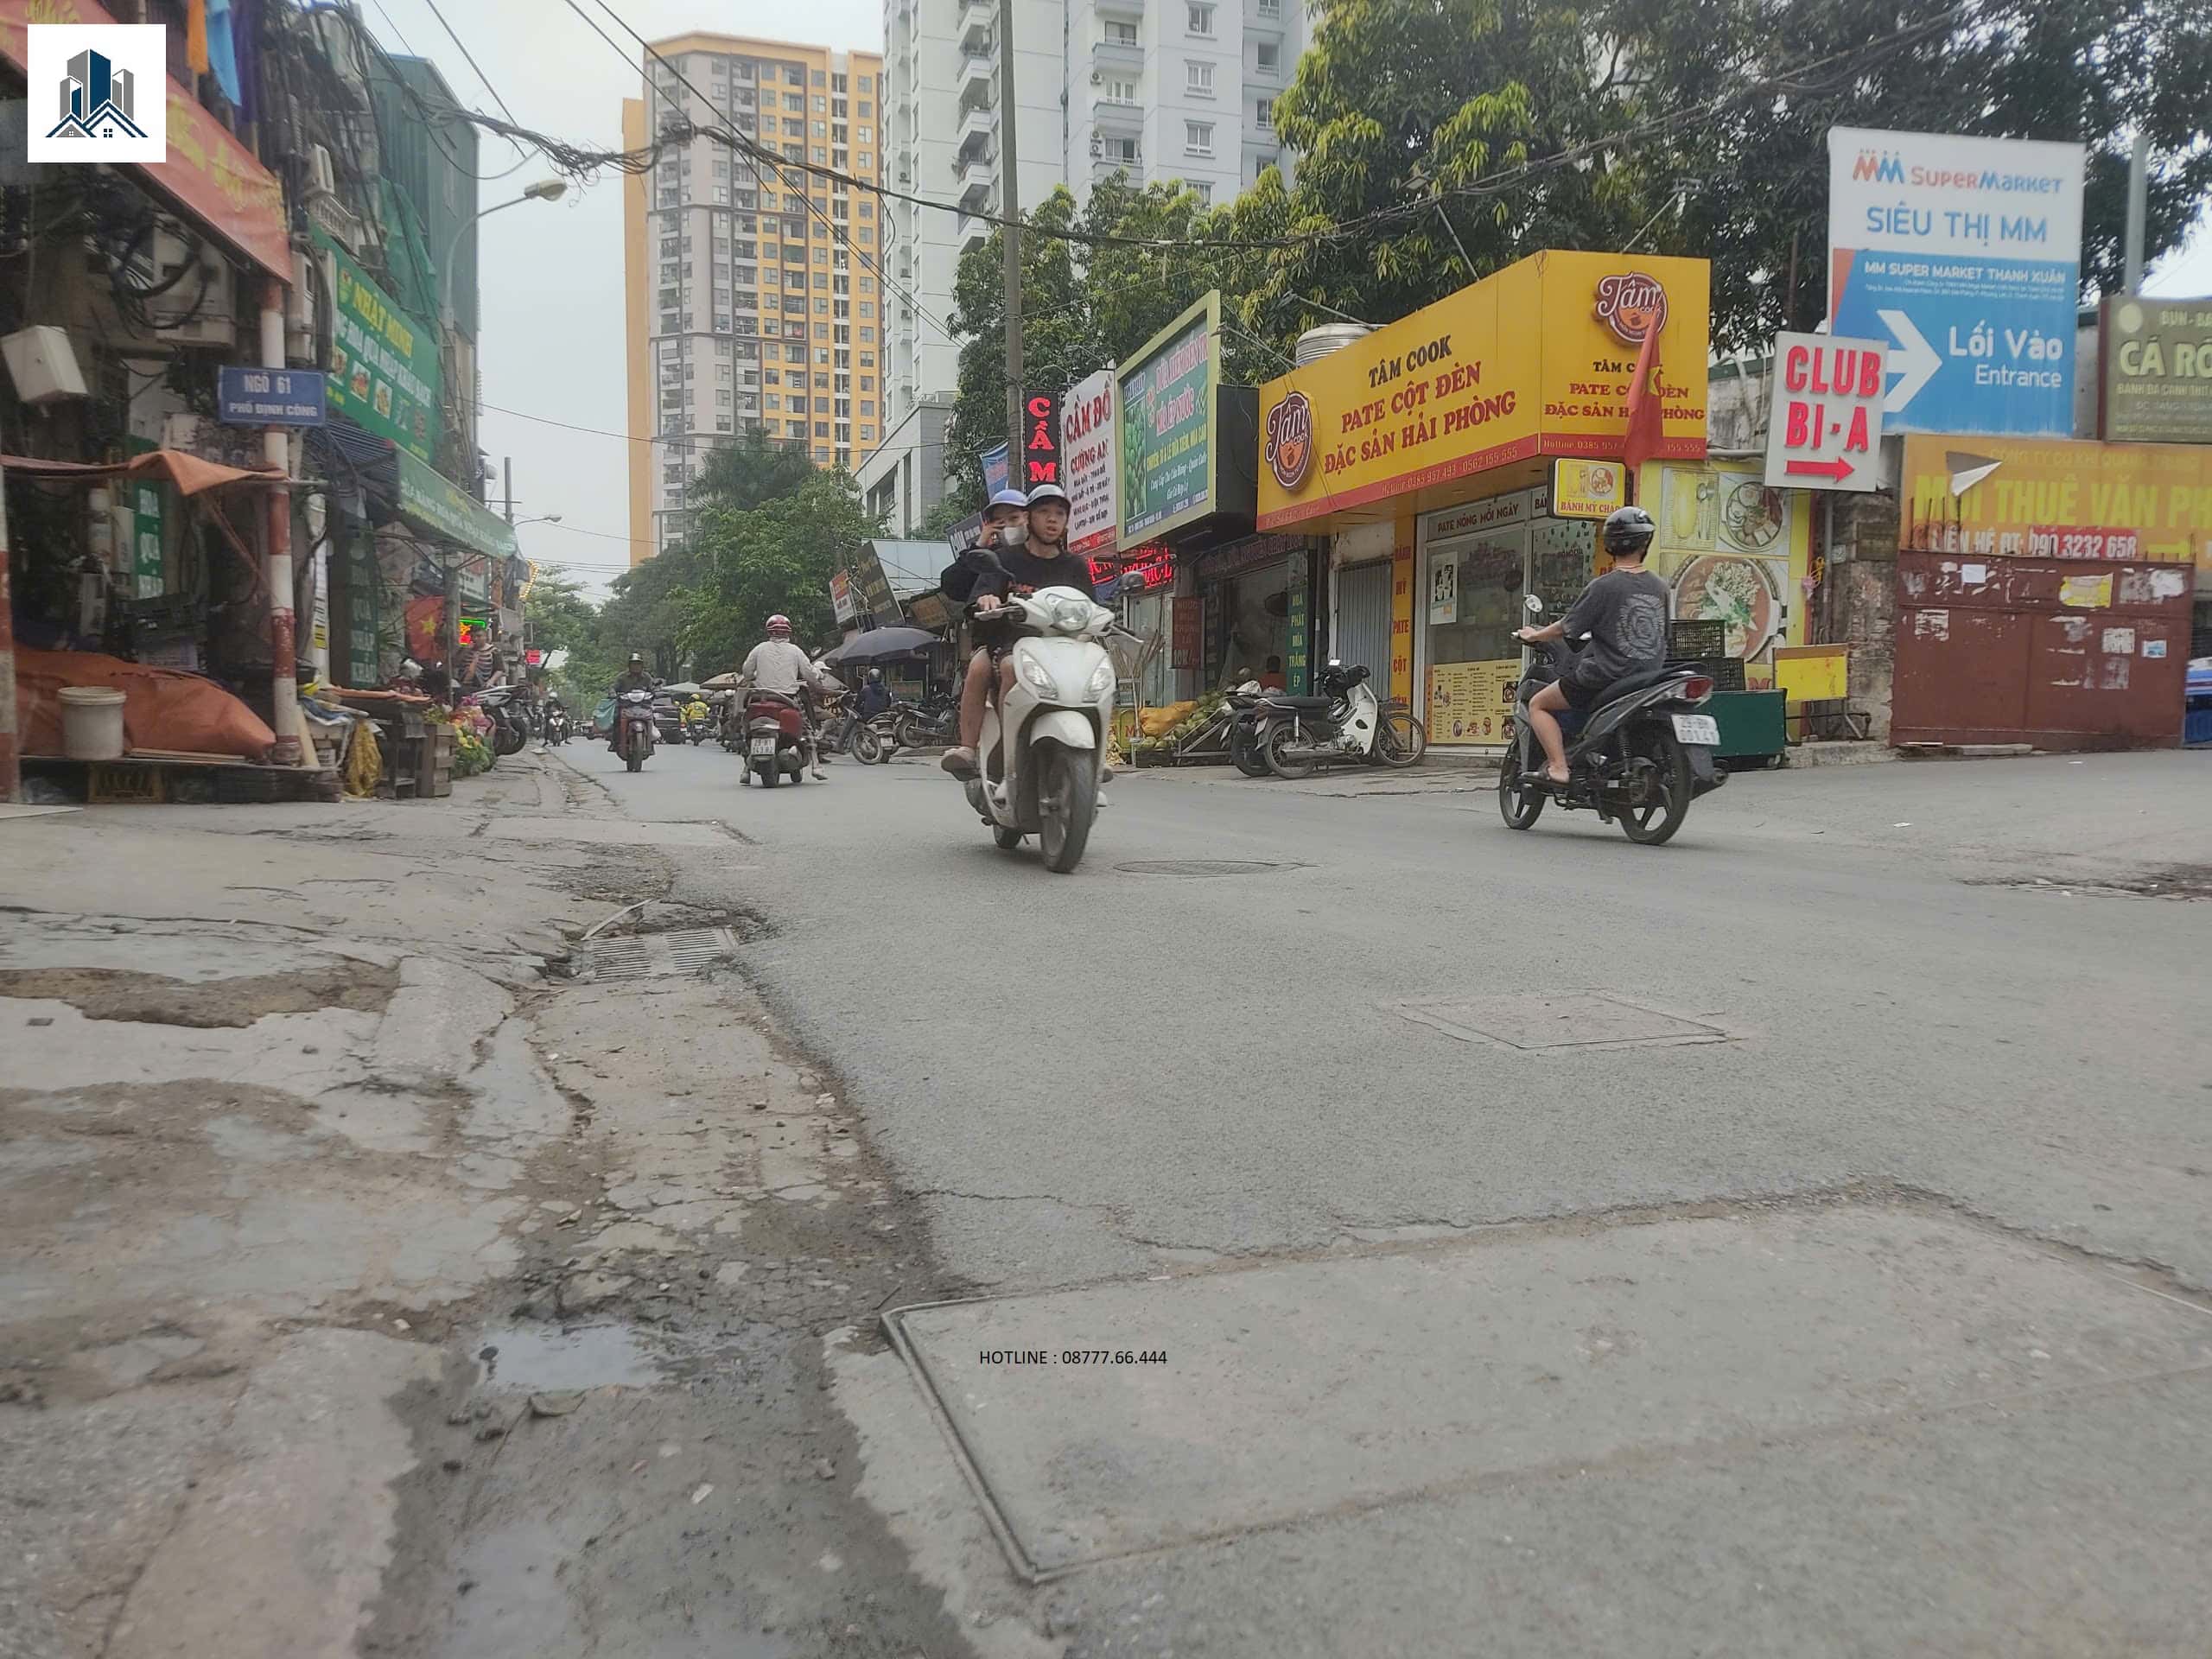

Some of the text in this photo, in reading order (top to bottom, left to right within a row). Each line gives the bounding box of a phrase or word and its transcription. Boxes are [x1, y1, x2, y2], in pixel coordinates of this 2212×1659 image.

[1866, 200, 2048, 246] SIÊU THỊ MM
[1865, 261, 2066, 284] MM SUPER MARKET THANH XUÂN
[1949, 319, 2063, 360] Lối Vào
[1369, 334, 1452, 388] TÂM COOK
[1593, 359, 1622, 372] TÂM
[2120, 335, 2166, 377] CÁ
[244, 372, 291, 394] NGÕ 61
[1785, 345, 1881, 397] CLUB
[1975, 364, 2062, 388] Entrance
[1341, 361, 1481, 433] PATE CỘT ĐÈN
[1569, 383, 1610, 396] PATE
[229, 400, 253, 414] PHỐ
[287, 403, 318, 416] CÔNG
[1065, 373, 1113, 444] CẦM ĐỒ
[1545, 402, 1579, 419] ĐẶC
[1582, 401, 1613, 417] SẢN
[1663, 406, 1704, 420] HÒNG
[1324, 443, 1356, 475] ĐẶC
[1361, 428, 1395, 462] SẢN
[1402, 412, 1437, 448] HẢI
[1444, 390, 1516, 435] PHÒNG
[1071, 438, 1109, 474] CƯỜNG AN
[1561, 499, 1584, 512] BÁNH
[1994, 474, 2080, 524] THUÊ
[2090, 474, 2158, 527] VĂN
[1437, 520, 1455, 533] PATE
[1457, 512, 1478, 528] NÓNG
[1497, 503, 1519, 519] NGÀY
[2106, 535, 2137, 558] 658
[1393, 619, 1409, 635] PATE
[1393, 655, 1407, 676] CỘT
